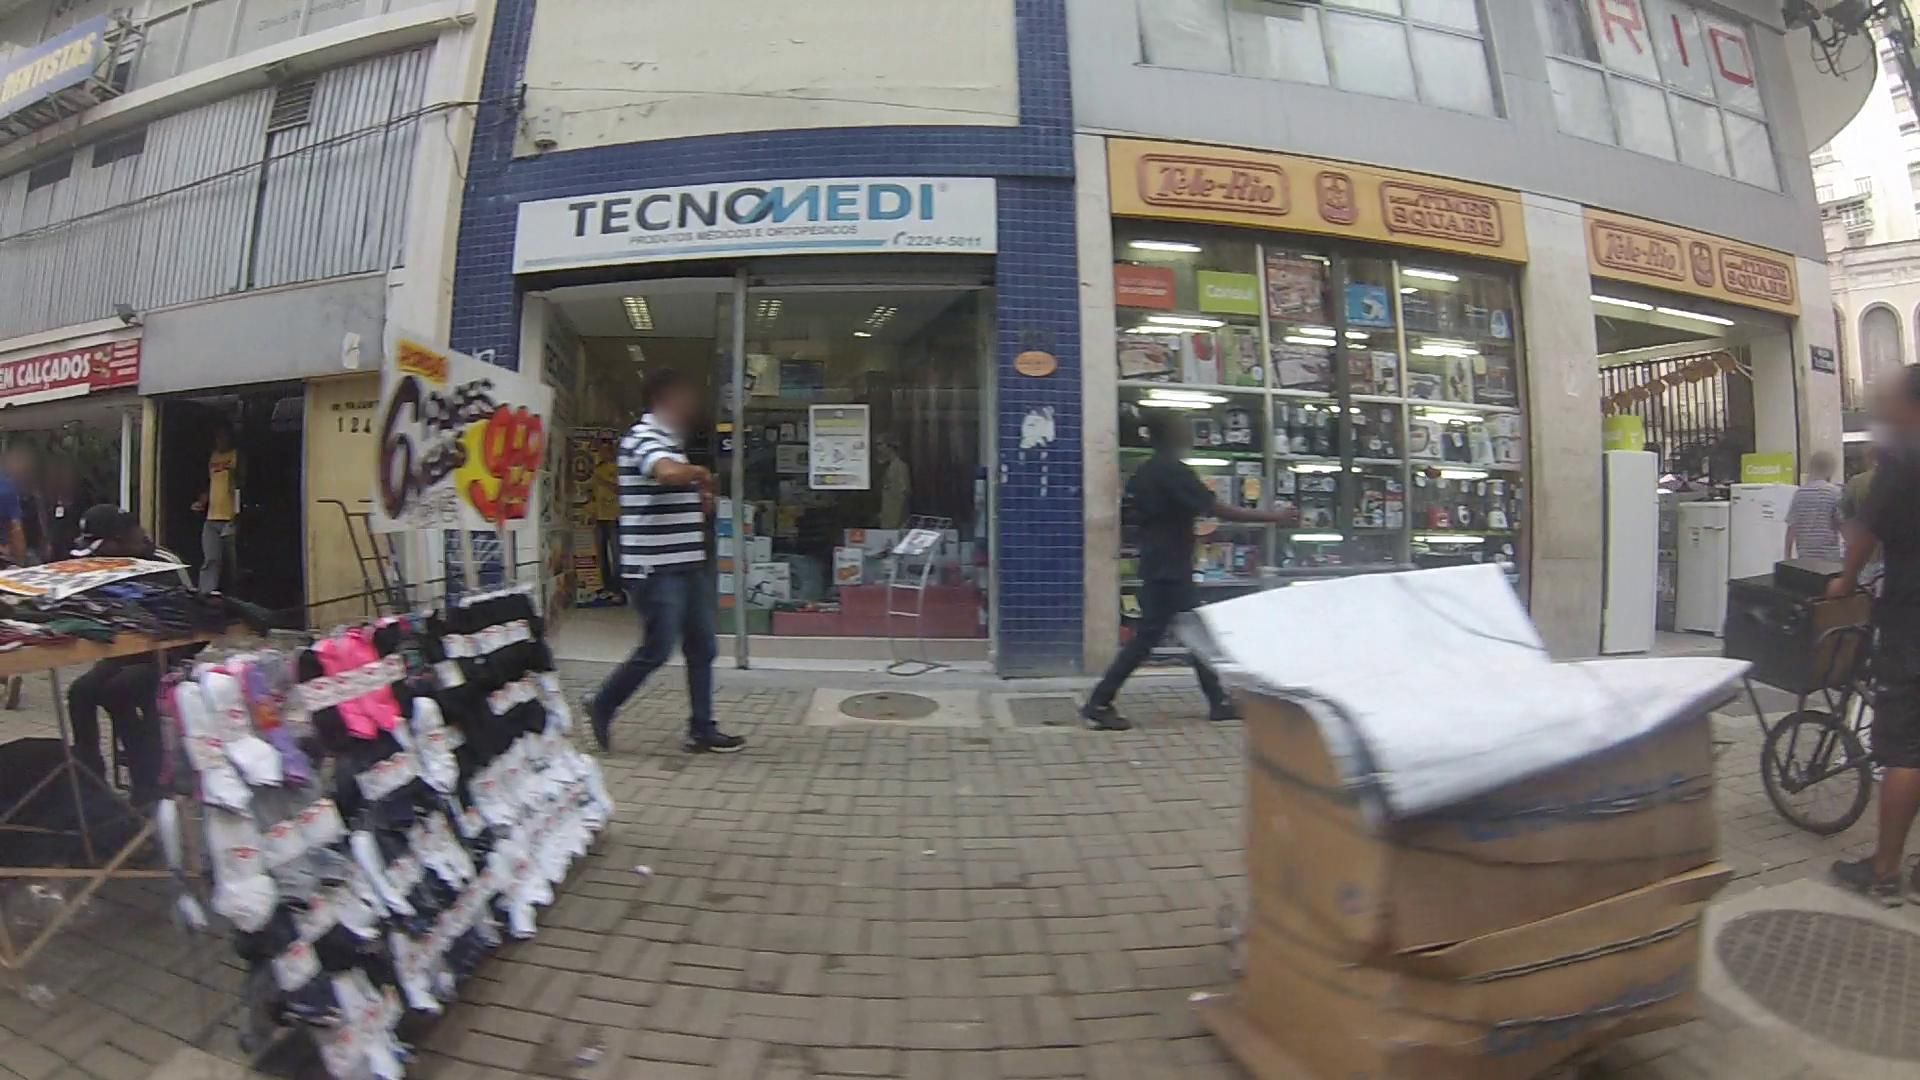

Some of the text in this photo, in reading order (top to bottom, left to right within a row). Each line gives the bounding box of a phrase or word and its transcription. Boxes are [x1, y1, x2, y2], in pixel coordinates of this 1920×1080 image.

[568, 183, 934, 237] TECNOMEDI
[1392, 206, 1496, 238] SQUARE
[629, 231, 693, 244] PRODUTOS
[755, 227, 761, 237] E
[16, 352, 92, 390] CALÇADOS
